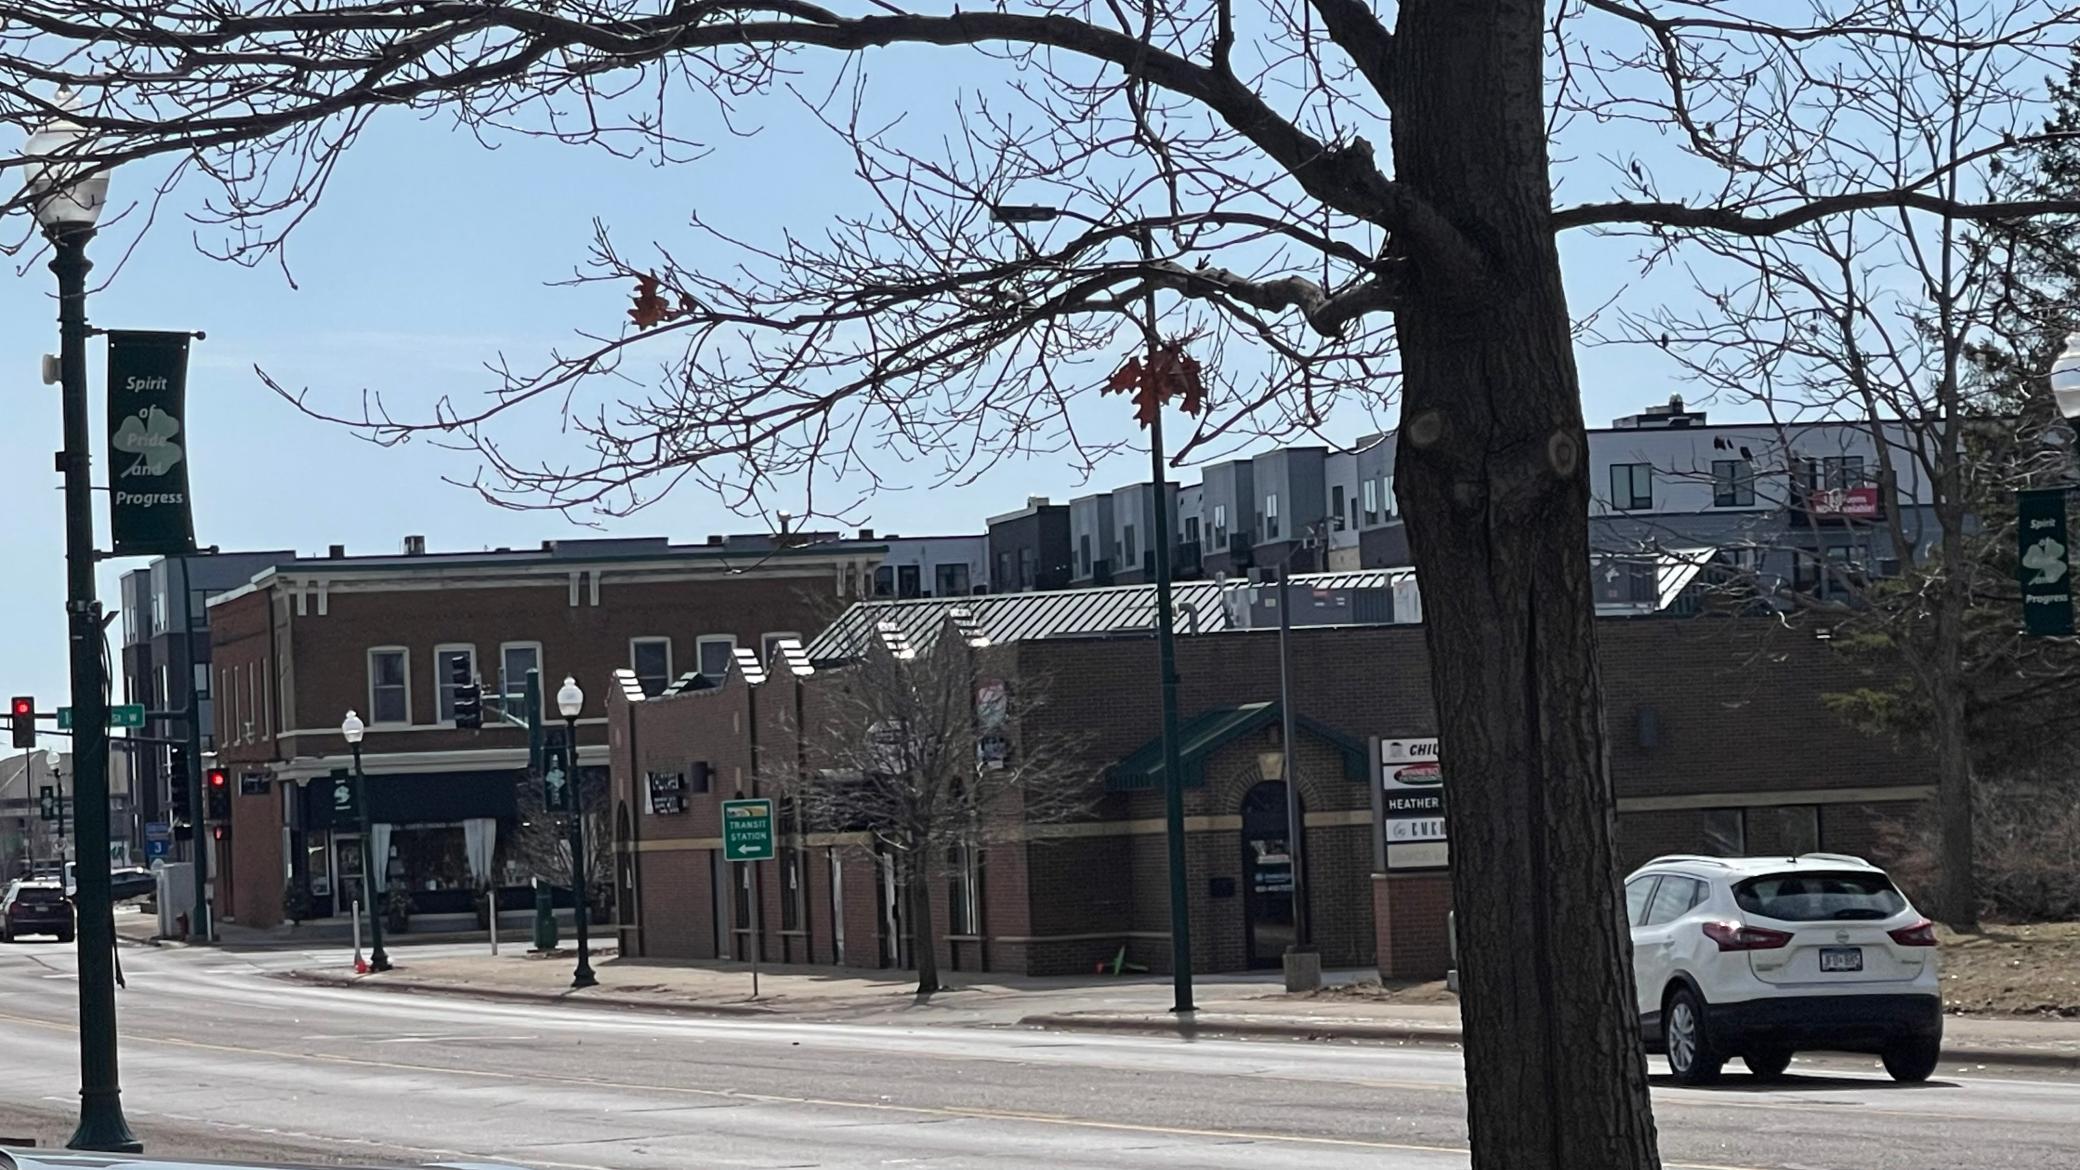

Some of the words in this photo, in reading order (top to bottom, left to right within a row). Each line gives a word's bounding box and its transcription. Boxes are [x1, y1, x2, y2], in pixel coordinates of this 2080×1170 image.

[126, 376, 167, 392] Spirit
[138, 404, 156, 419] of
[127, 433, 168, 446] Pride
[131, 461, 163, 476] and
[116, 491, 183, 507] Progress
[2030, 519, 2056, 530] Spirit
[2026, 594, 2068, 605] Progress
[1410, 744, 1439, 756] CHIL
[1389, 797, 1439, 809] HEATHER
[729, 820, 767, 830] TRANSIT
[730, 832, 767, 842] STATION
